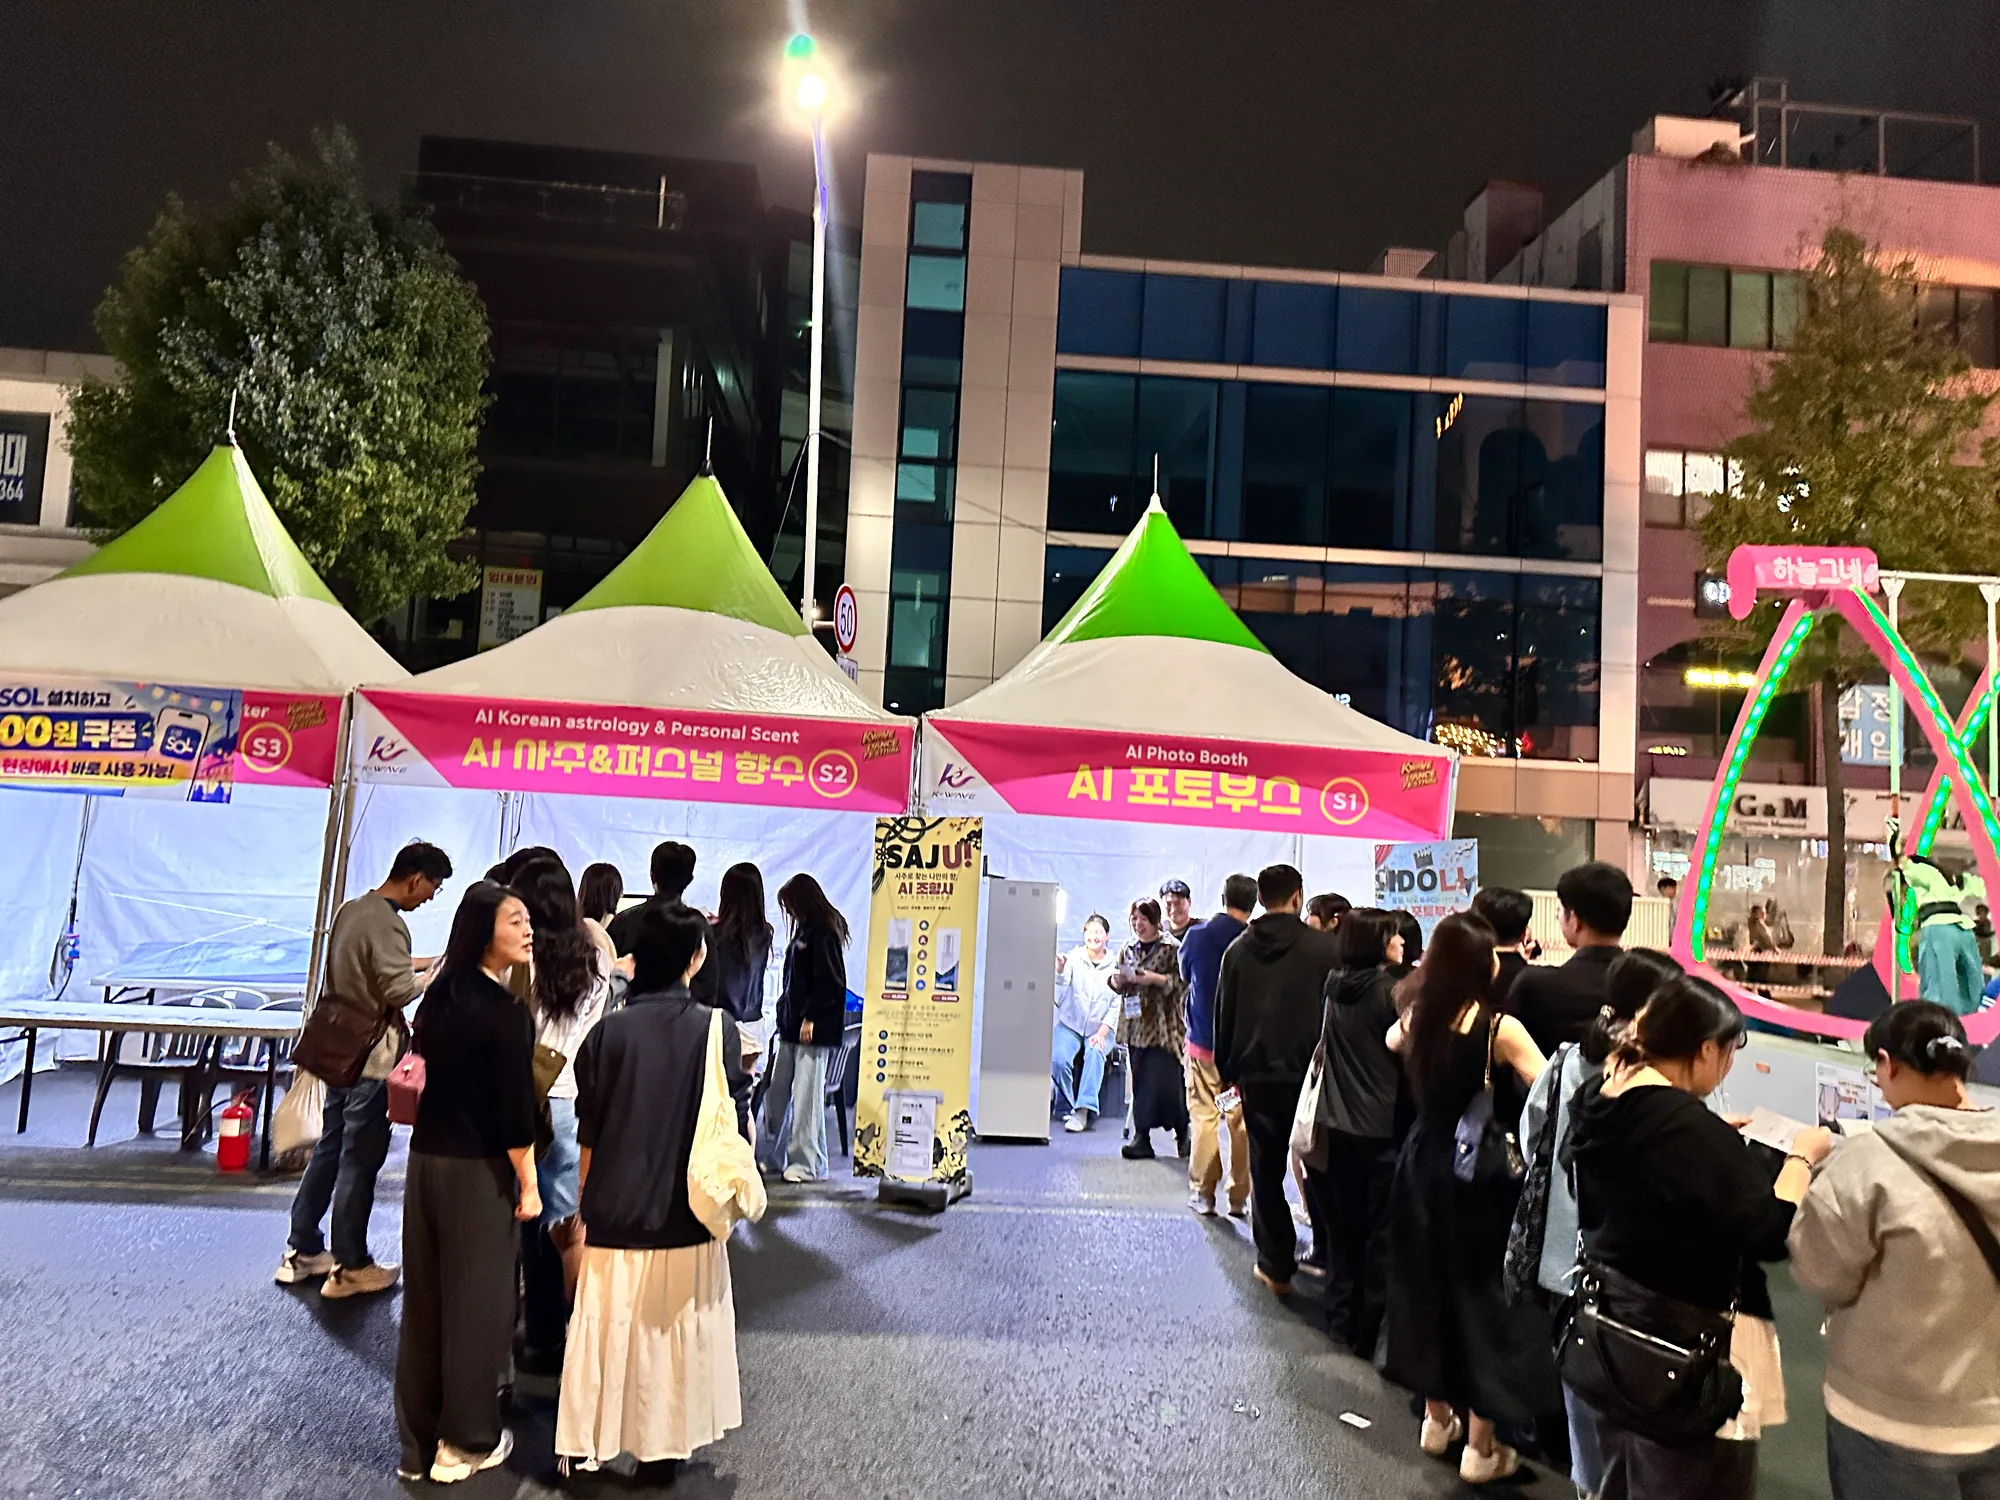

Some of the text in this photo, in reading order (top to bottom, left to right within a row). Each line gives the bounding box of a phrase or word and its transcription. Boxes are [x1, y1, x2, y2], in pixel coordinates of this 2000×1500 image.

[1773, 556, 1862, 586] 하늘그네
[840, 603, 853, 637] 50
[0, 688, 111, 707] SOL 설치하고
[82, 719, 136, 748] 쿠폰
[475, 708, 799, 744] AI Korean astrology & Personal Scent
[252, 737, 281, 758] S3
[1126, 744, 1248, 767] AI Photo Booth
[71, 761, 101, 776] 바로
[104, 762, 135, 777] 사용
[139, 763, 174, 778] 가능!
[462, 737, 502, 768] AI
[735, 750, 805, 787] 향수
[819, 763, 848, 784] S2
[1067, 764, 1301, 816] AI 포토부스
[1333, 792, 1357, 811] S1
[886, 841, 972, 869] SAJU!
[898, 882, 913, 894] AI
